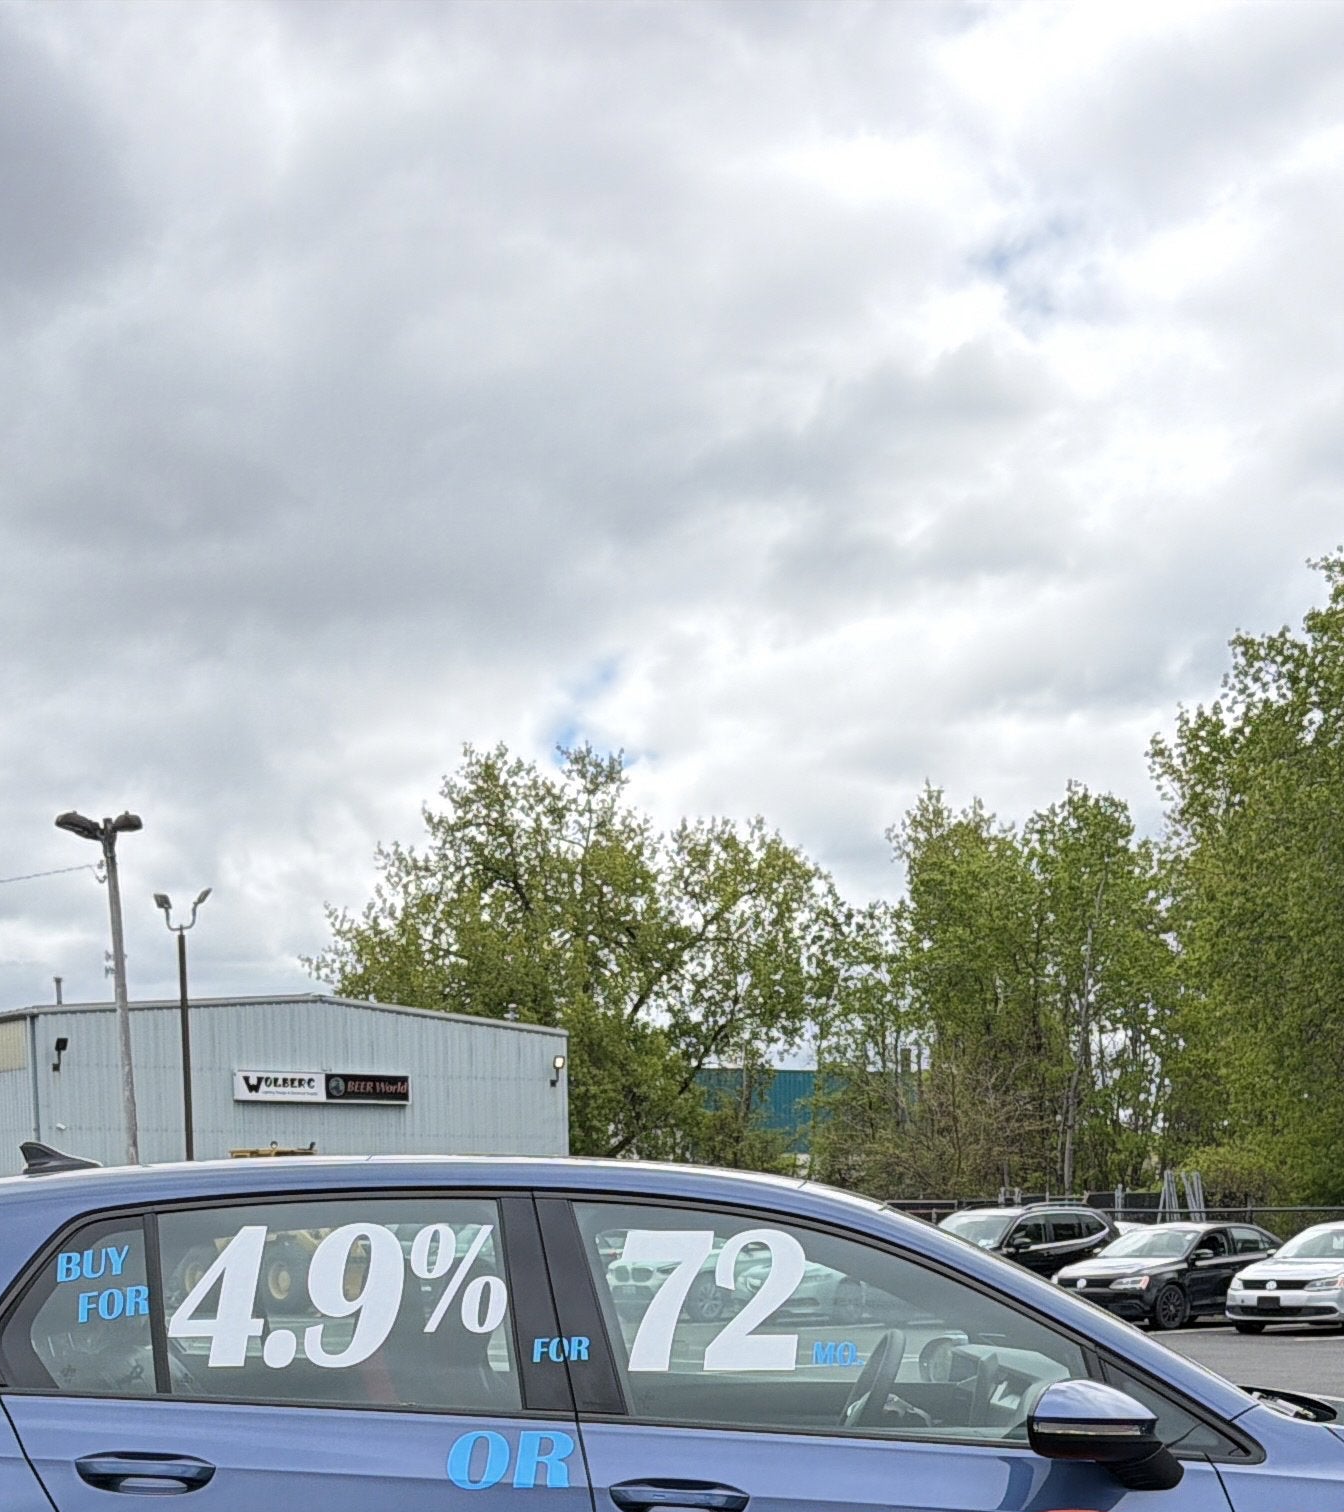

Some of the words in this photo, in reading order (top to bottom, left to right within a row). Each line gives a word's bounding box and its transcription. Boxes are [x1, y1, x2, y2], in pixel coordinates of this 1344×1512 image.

[347, 1080, 373, 1093] BEER
[375, 1080, 408, 1094] World
[57, 1245, 129, 1283] BUY
[78, 1285, 149, 1323] FOR
[168, 1222, 508, 1369] 4.9%
[532, 1336, 590, 1363] FOR
[621, 1228, 806, 1372] 72
[446, 1430, 575, 1490] OR
